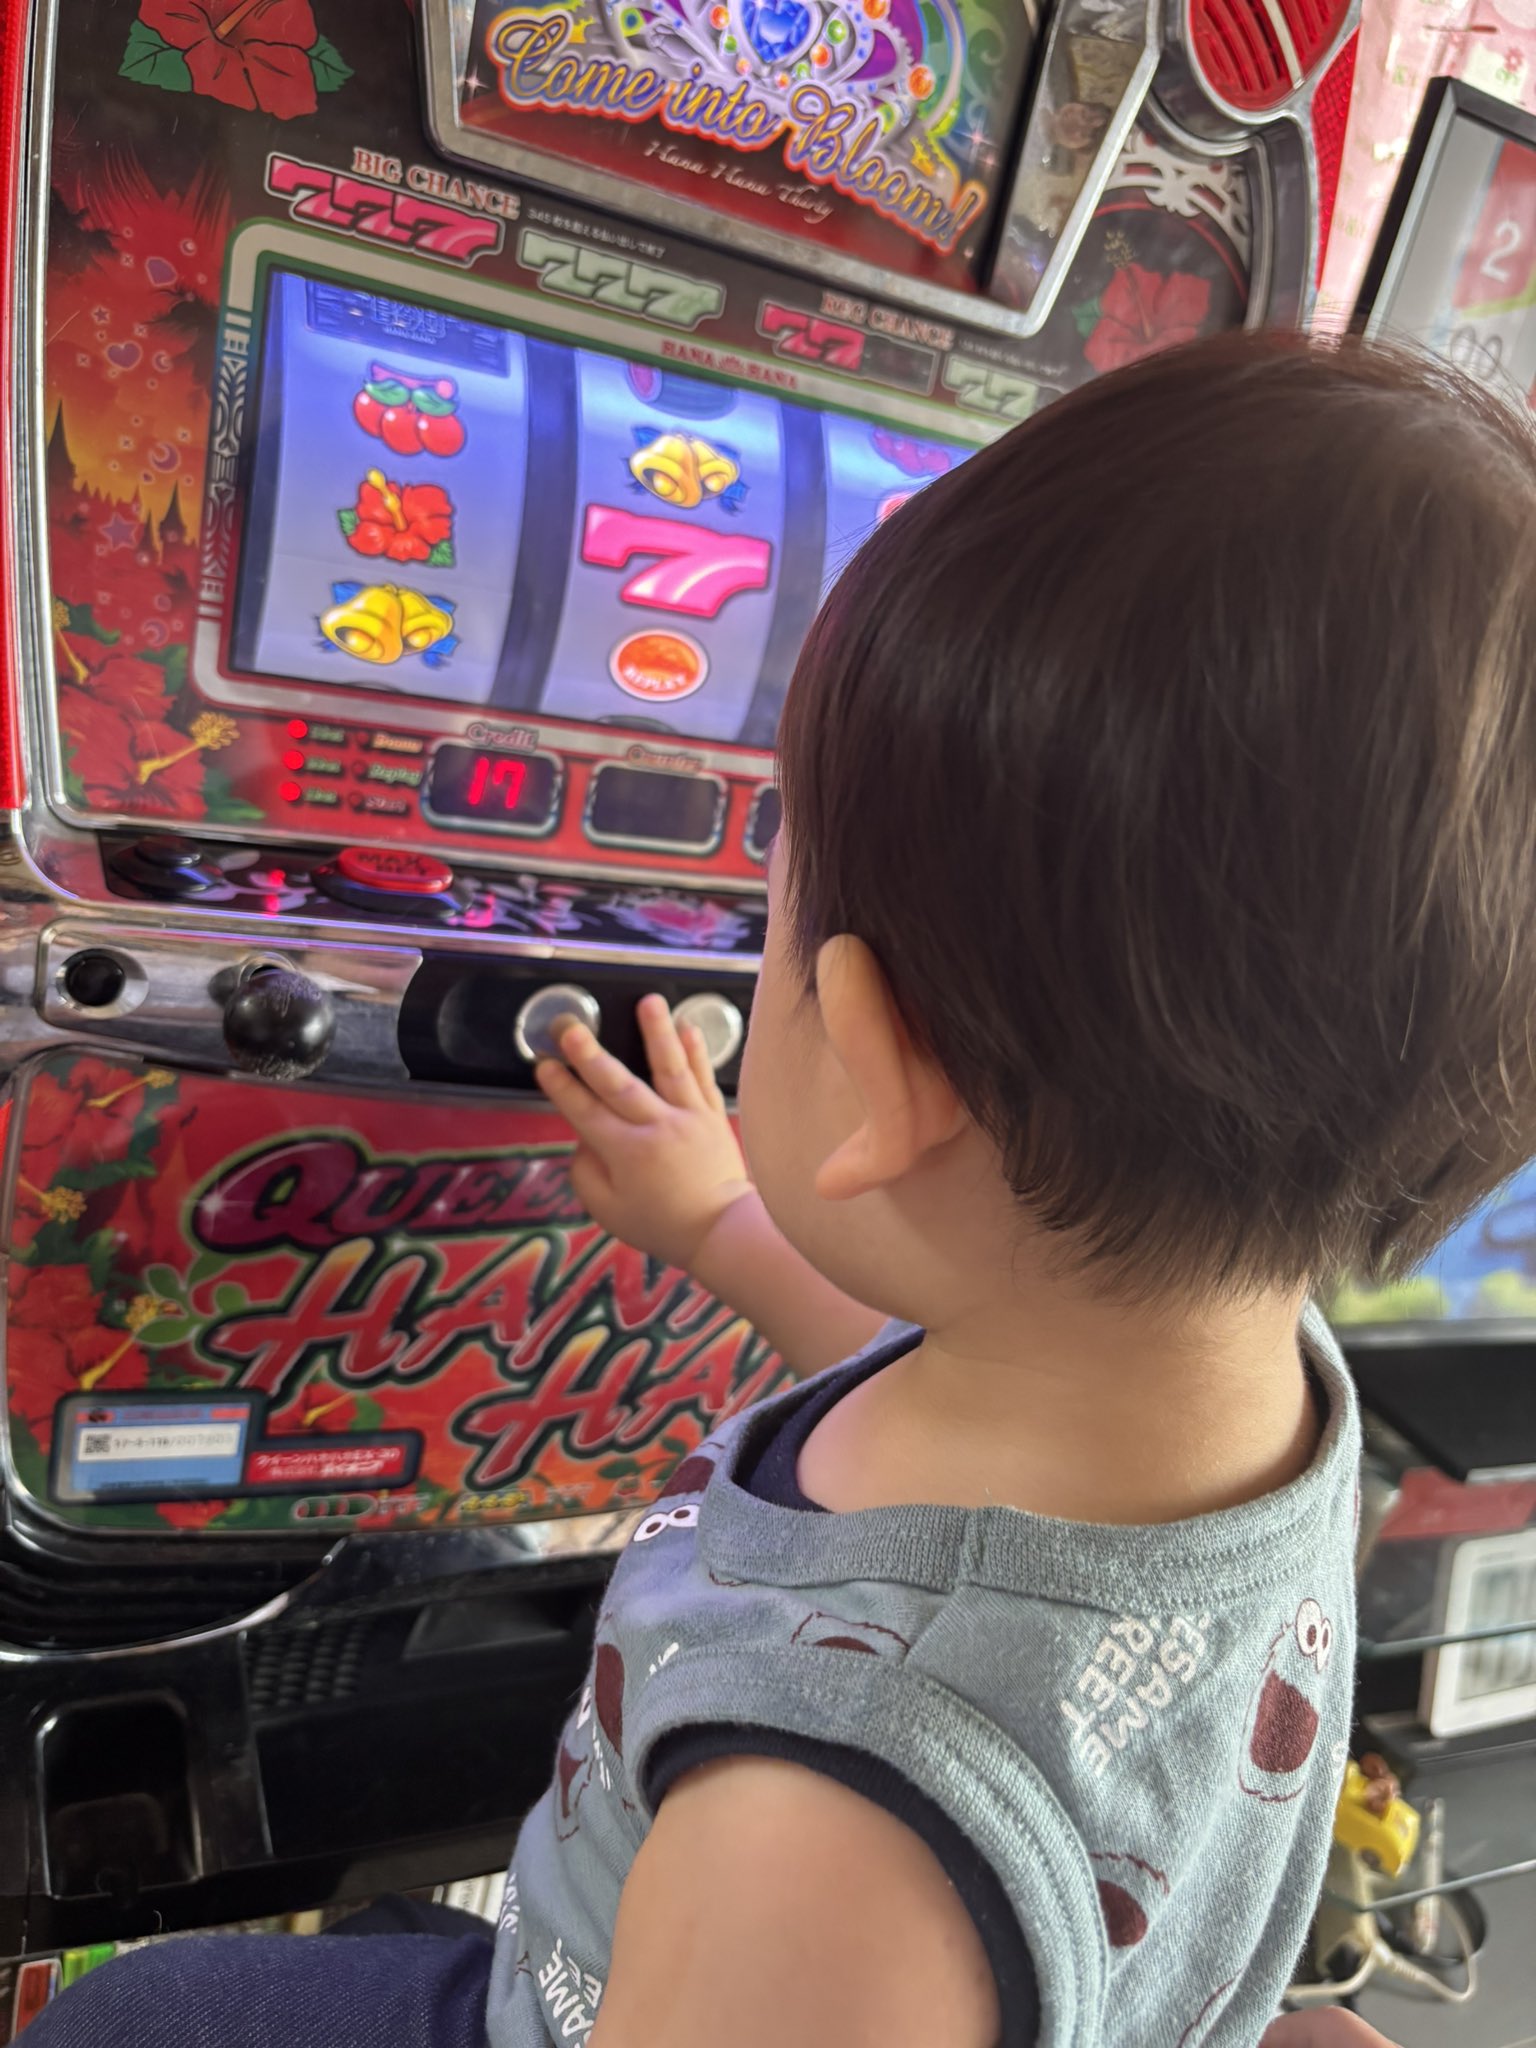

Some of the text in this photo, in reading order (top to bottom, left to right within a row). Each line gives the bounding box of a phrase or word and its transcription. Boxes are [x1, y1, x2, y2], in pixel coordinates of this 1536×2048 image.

[490, 12, 982, 246] Come into Bloom!
[353, 147, 520, 220] BIG CHANCE
[644, 141, 708, 174] Hana
[711, 163, 773, 196] Hana
[266, 153, 503, 267] 777
[517, 230, 725, 330] 777
[868, 306, 955, 351] CHANCE
[466, 722, 538, 751] Credit
[467, 756, 527, 810] 17
[190, 1130, 590, 1252] QUEE
